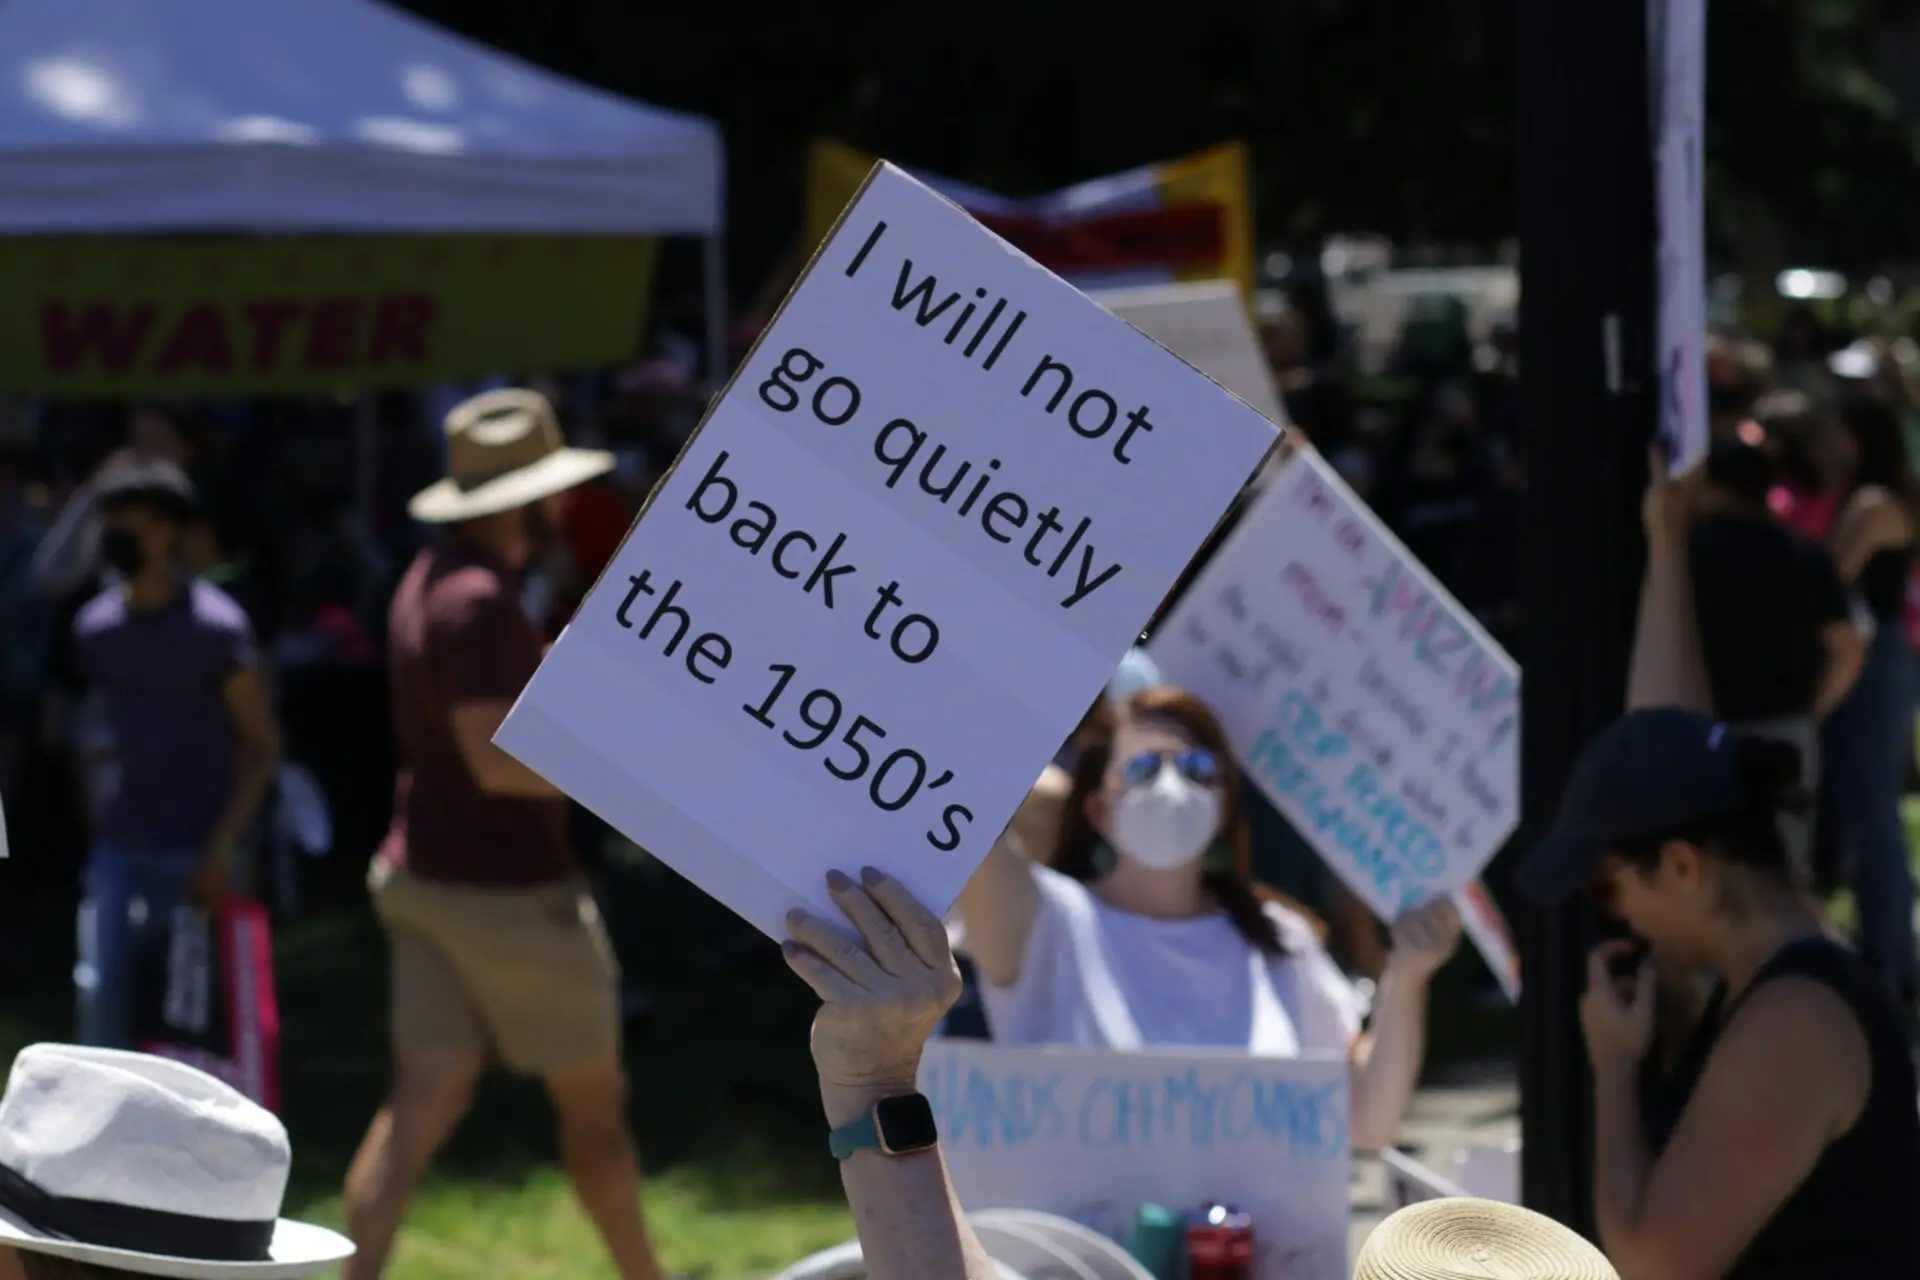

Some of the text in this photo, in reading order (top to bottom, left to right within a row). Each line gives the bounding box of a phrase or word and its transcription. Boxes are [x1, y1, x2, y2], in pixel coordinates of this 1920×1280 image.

[38, 292, 440, 376] WATER
[844, 220, 888, 278] I
[890, 258, 1028, 372] will
[1019, 354, 1154, 465] not
[685, 450, 940, 664] back to
[758, 347, 1123, 609] go quietly
[615, 569, 974, 852] the 1950's
[928, 1053, 1065, 1150] HANDS
